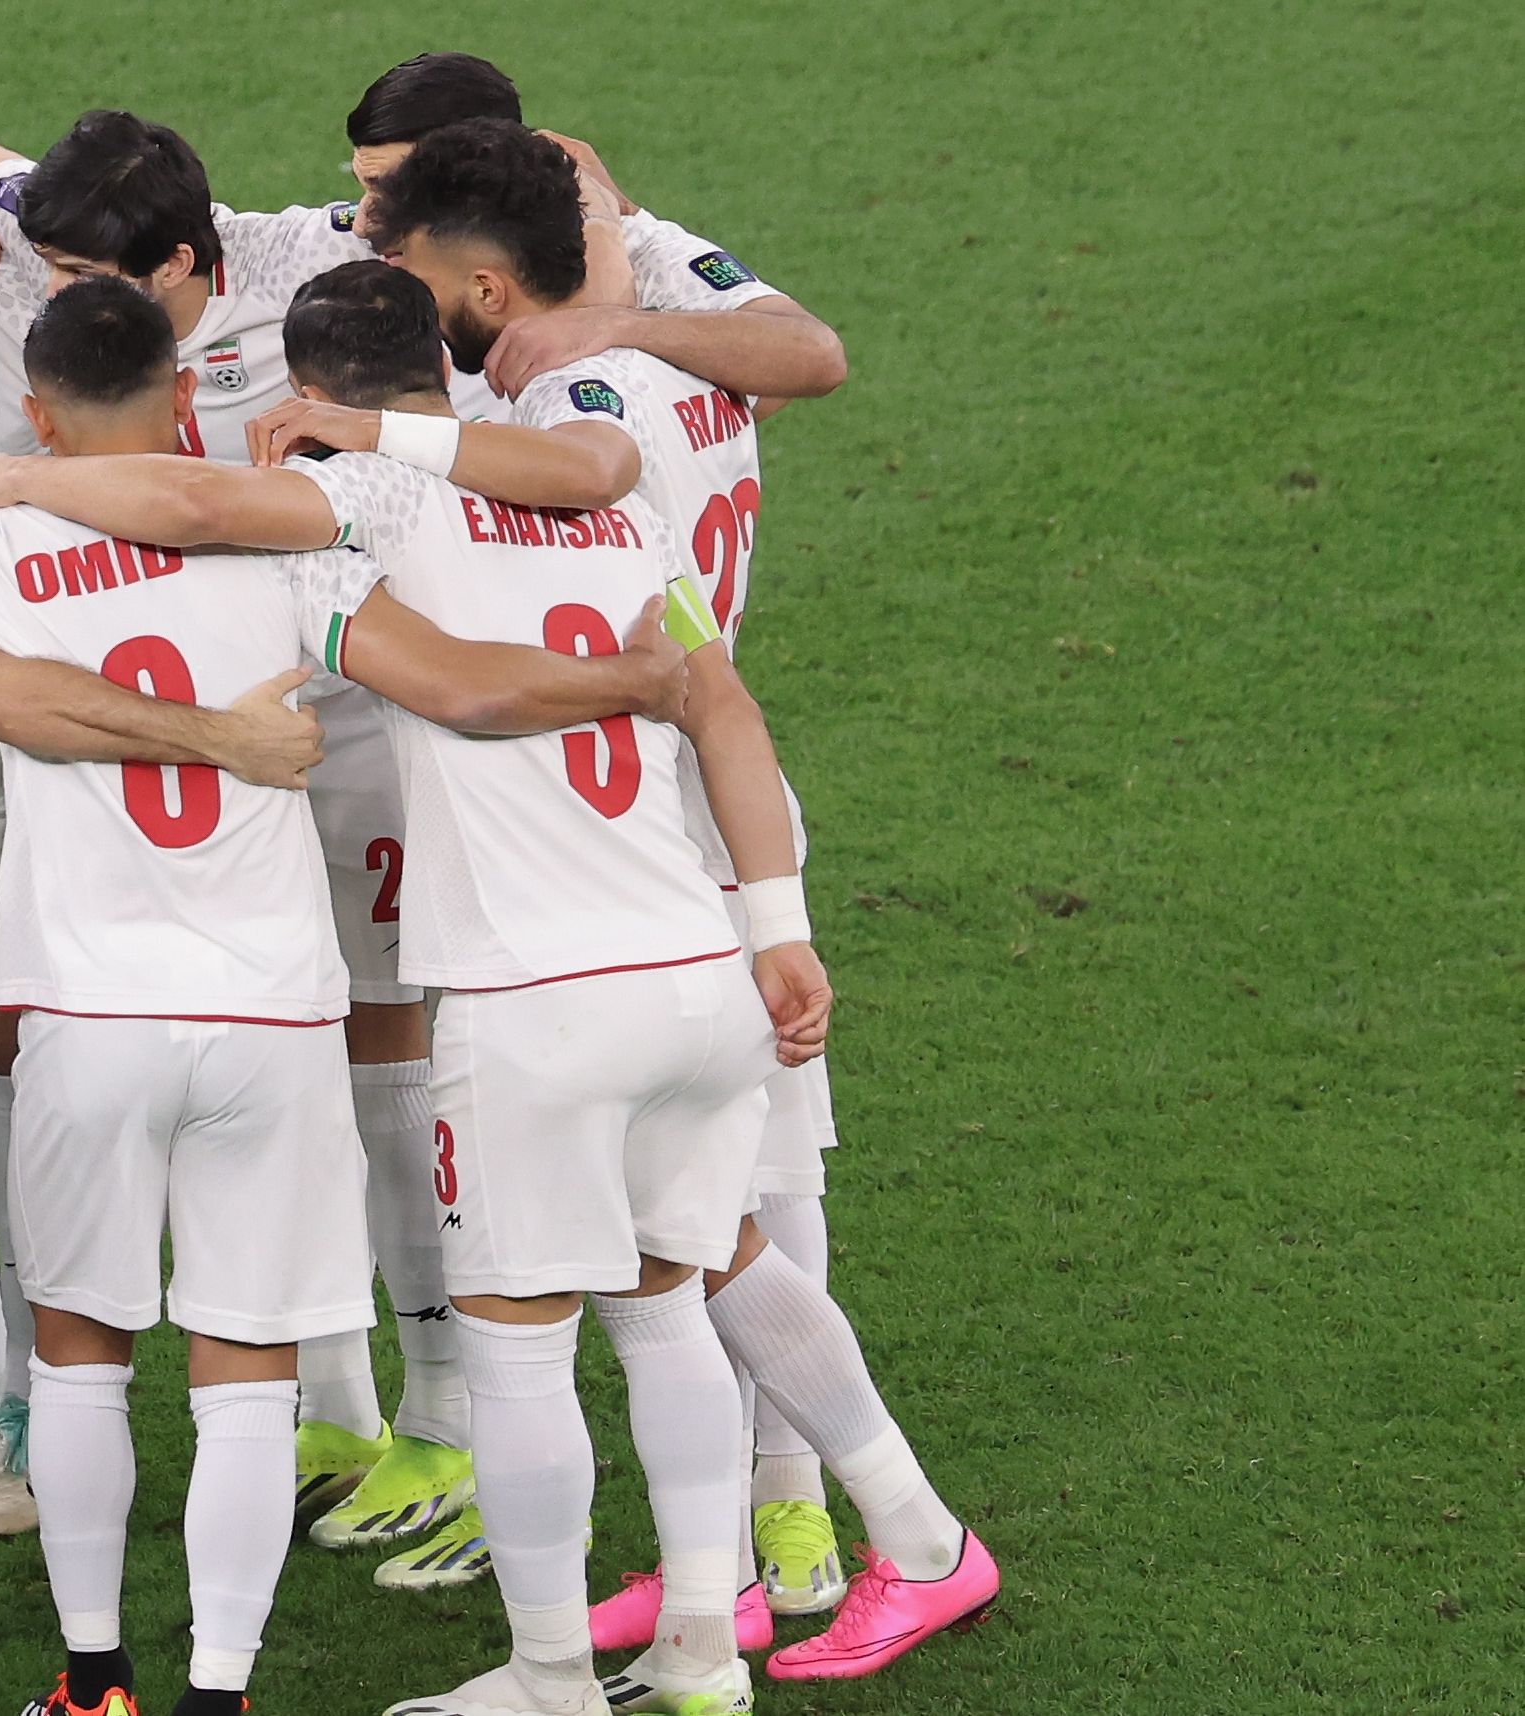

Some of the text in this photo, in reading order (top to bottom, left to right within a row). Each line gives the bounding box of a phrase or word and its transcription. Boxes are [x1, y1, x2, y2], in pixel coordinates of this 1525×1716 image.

[697, 257, 719, 271] AFC
[703, 261, 739, 279] LIVE
[578, 383, 601, 391] AFC
[15, 536, 183, 603] OMID
[434, 1119, 458, 1207] 3
